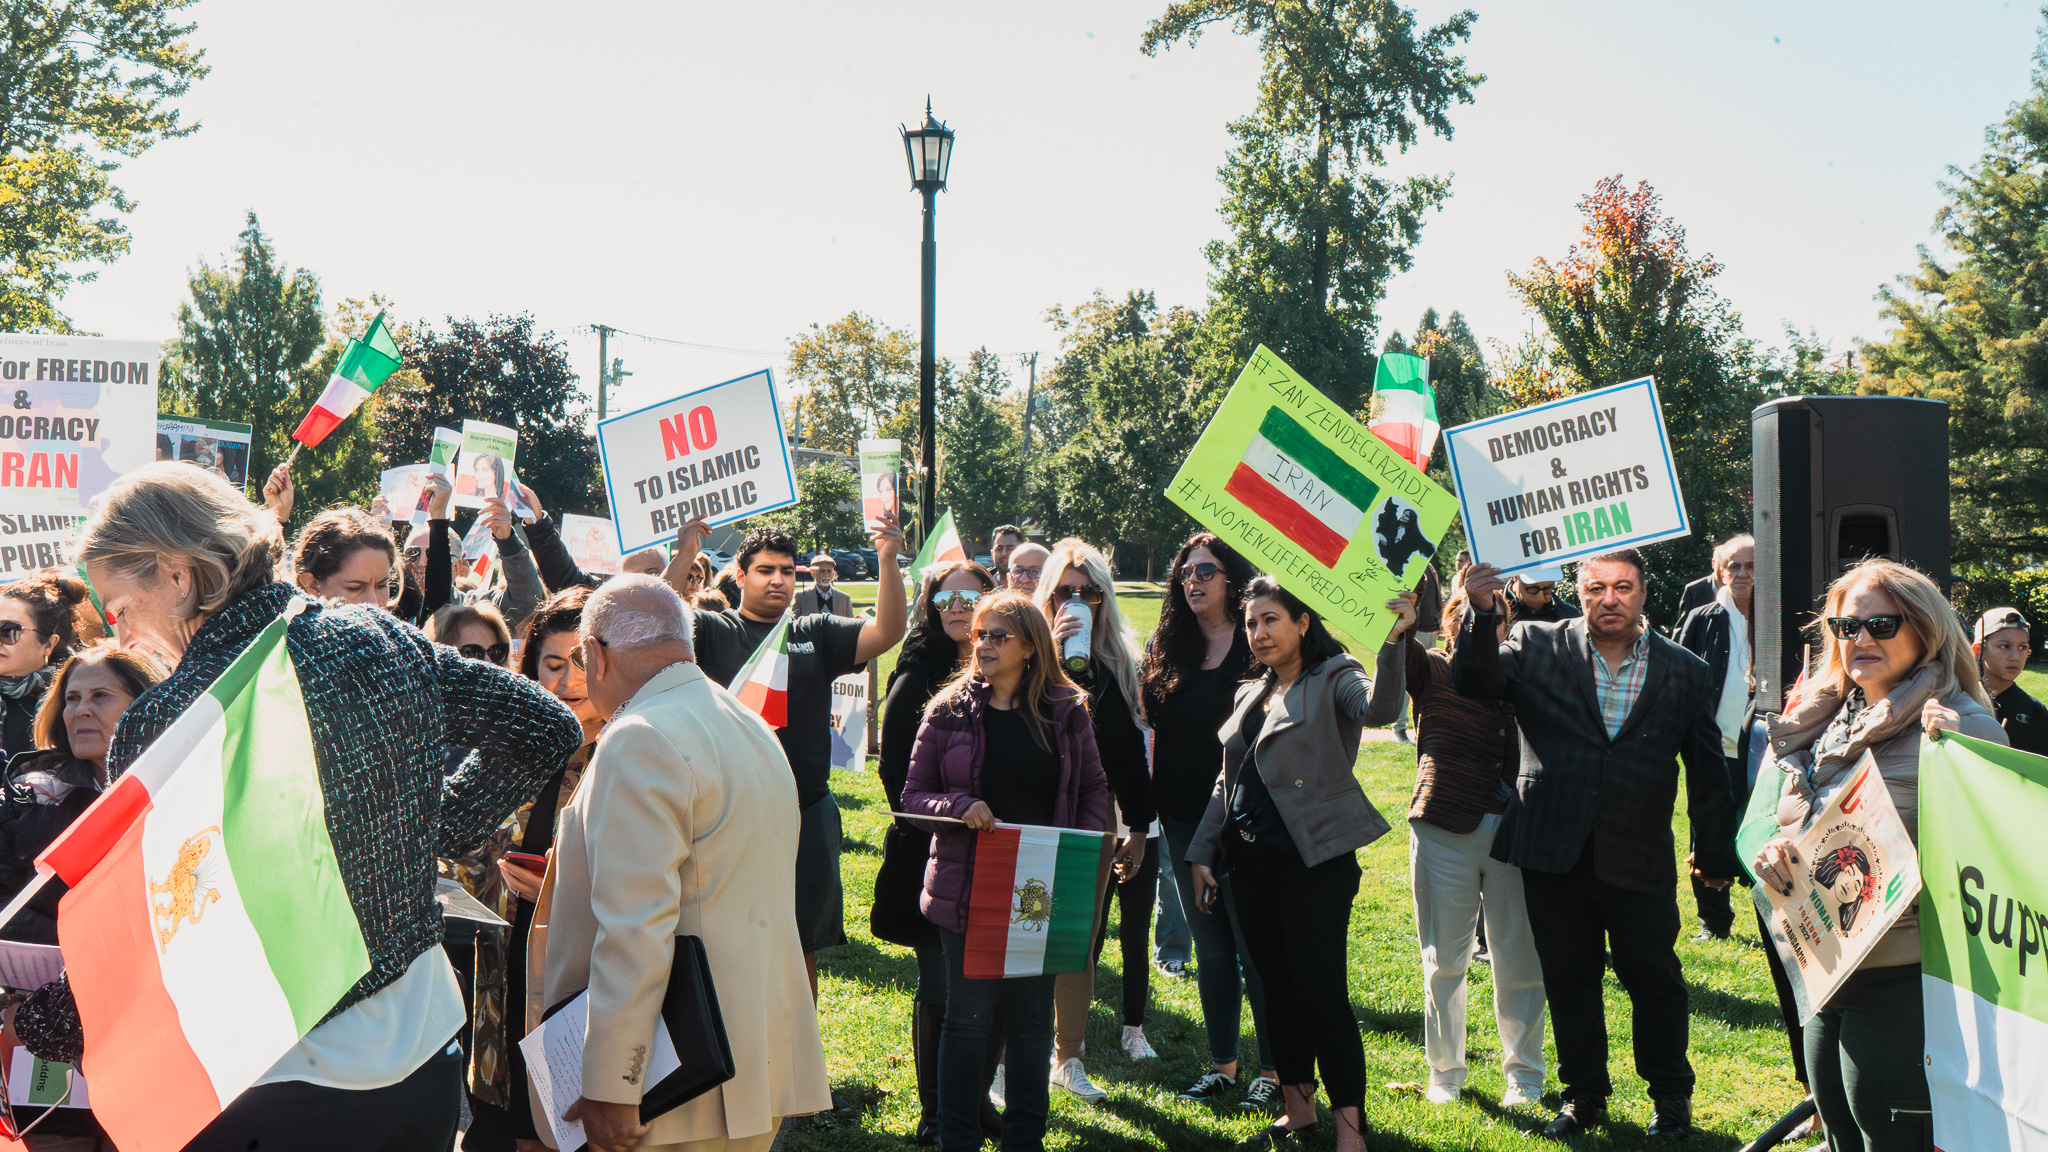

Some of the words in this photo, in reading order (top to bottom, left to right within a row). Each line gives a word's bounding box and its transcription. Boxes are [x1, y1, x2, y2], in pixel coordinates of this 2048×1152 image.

[33, 338, 44, 346] of
[46, 339, 67, 347] Iran
[36, 358, 149, 385] FREEDOM
[13, 390, 32, 410] &
[659, 405, 718, 462] NO
[1487, 406, 1618, 463] DEMOCRACY
[1, 451, 79, 489] RAN
[633, 475, 664, 504] TO
[666, 445, 761, 495] ISLAMIC
[1267, 453, 1334, 511] IRAN
[1550, 457, 1568, 479] &
[650, 480, 758, 535] REPUBLIC
[1486, 484, 1567, 527] HUMAN
[1567, 464, 1650, 507] RIGHTS
[1519, 526, 1563, 558] FOR
[1562, 501, 1633, 547] IRAN
[1798, 905, 1822, 947] FREEDOM
[1798, 922, 1811, 941] 2022
[1803, 898, 1827, 940] LIFE
[1809, 888, 1835, 932] WOMAN
[1781, 918, 1809, 970] #MAHSAAMINI
